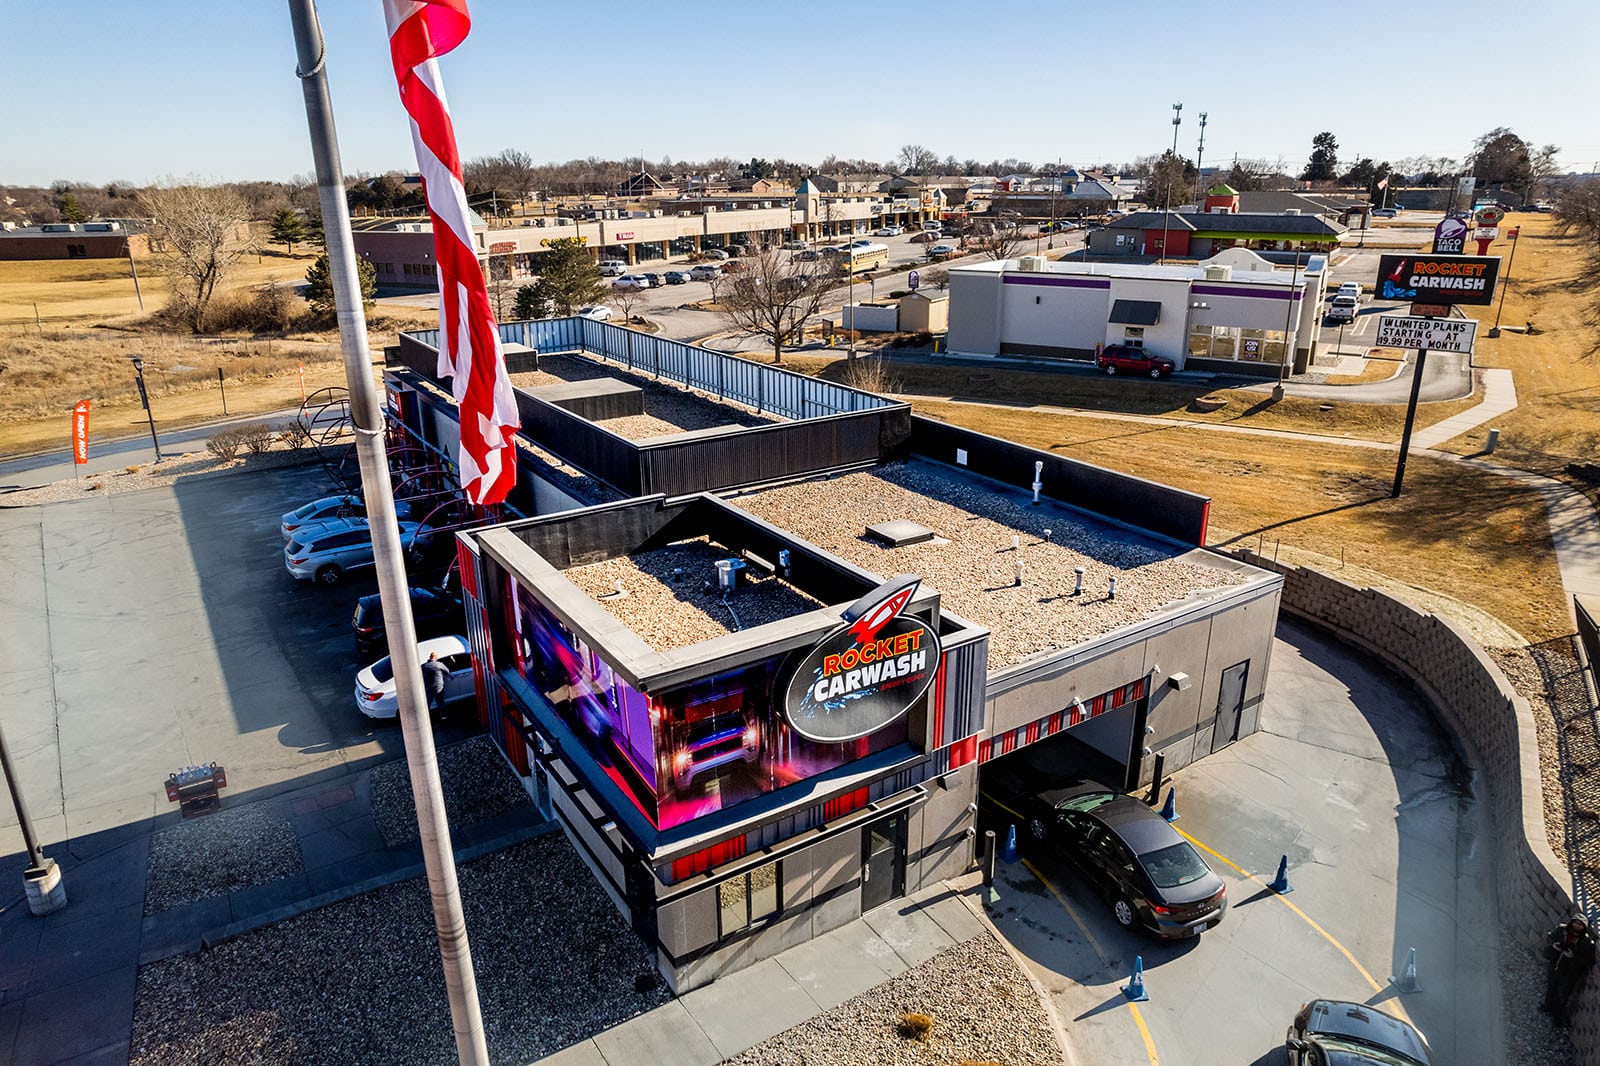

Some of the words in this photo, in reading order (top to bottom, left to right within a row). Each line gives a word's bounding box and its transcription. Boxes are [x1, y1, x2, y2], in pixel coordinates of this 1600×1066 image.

[1413, 262, 1486, 276] ROCKET
[1409, 276, 1486, 290] CARWASH
[1412, 304, 1448, 316] OPEN
[1434, 322, 1466, 332] PLANS
[1383, 328, 1432, 338] STARTING
[1445, 333, 1459, 341] AT
[1404, 338, 1422, 348] PER
[1428, 341, 1461, 350] MONTH
[824, 628, 924, 676] ROCKET
[814, 650, 926, 702] CARWASH
